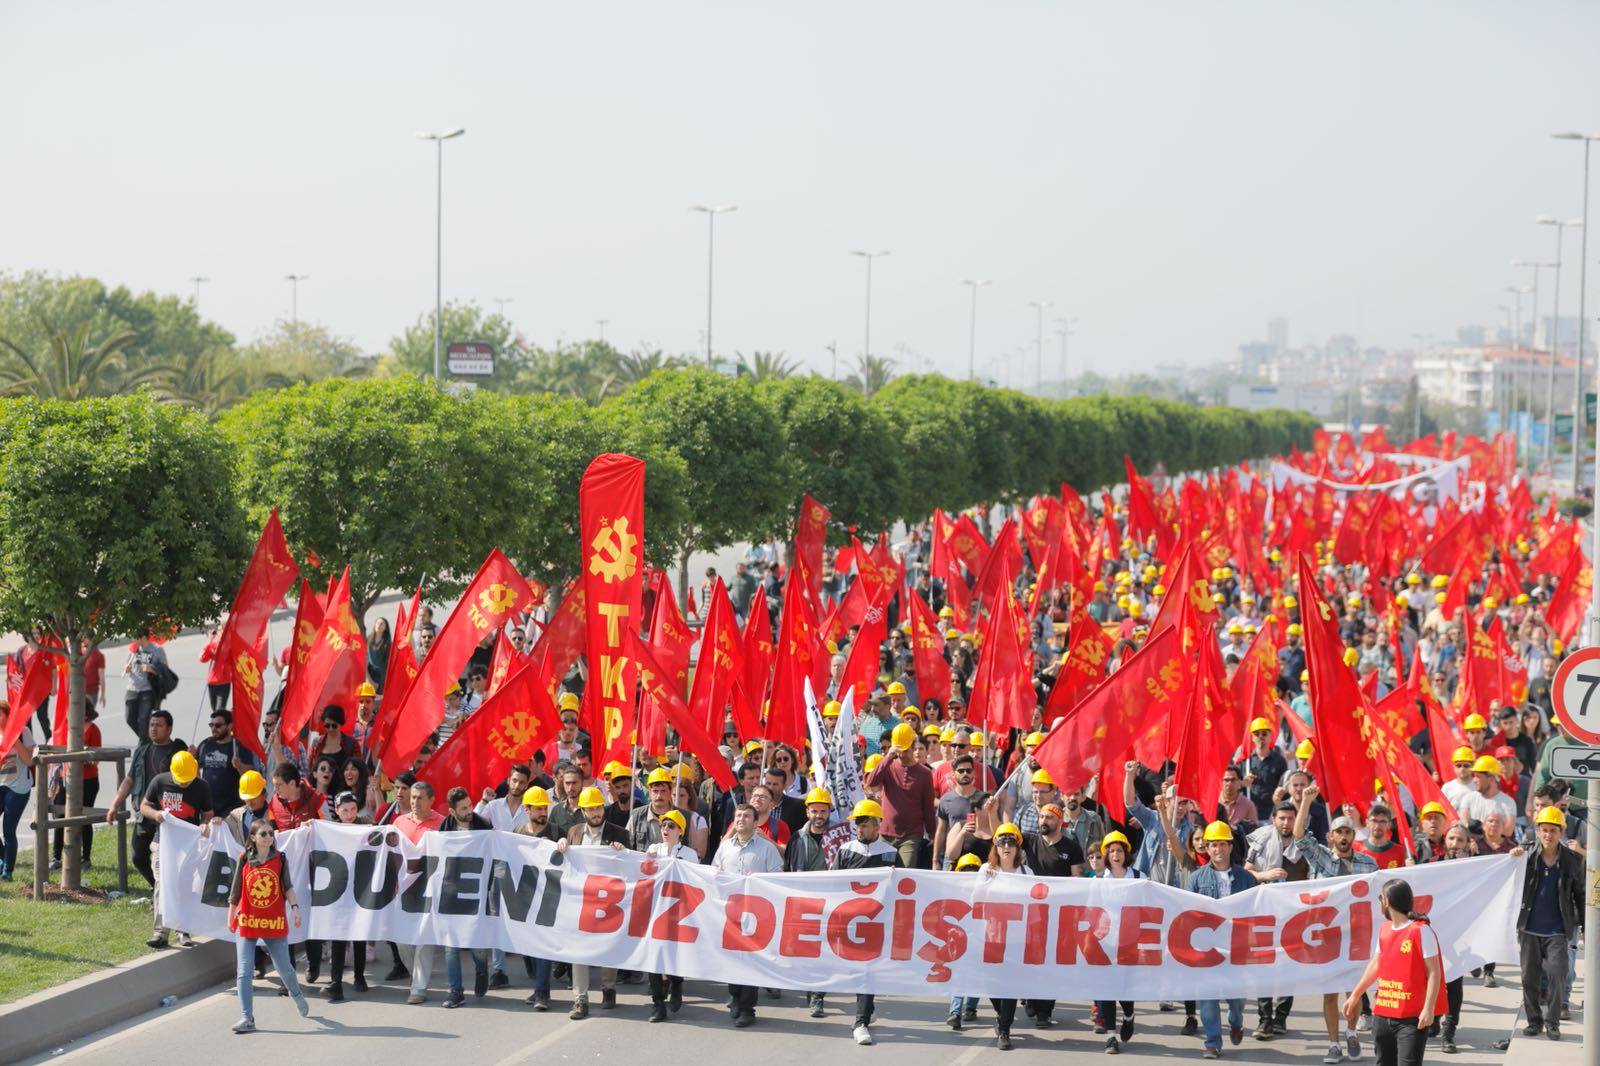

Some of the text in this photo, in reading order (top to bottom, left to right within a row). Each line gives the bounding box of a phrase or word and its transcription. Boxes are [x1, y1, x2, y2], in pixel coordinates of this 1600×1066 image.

[467, 603, 489, 630] TKP
[570, 602, 586, 624] TK
[598, 602, 631, 751] TKP
[1070, 656, 1098, 677] TKP
[487, 728, 517, 760] TKP
[308, 831, 563, 928] DÜZENİ
[577, 859, 704, 944] BİZ
[252, 897, 271, 907] TKP
[237, 913, 285, 931] Görevli
